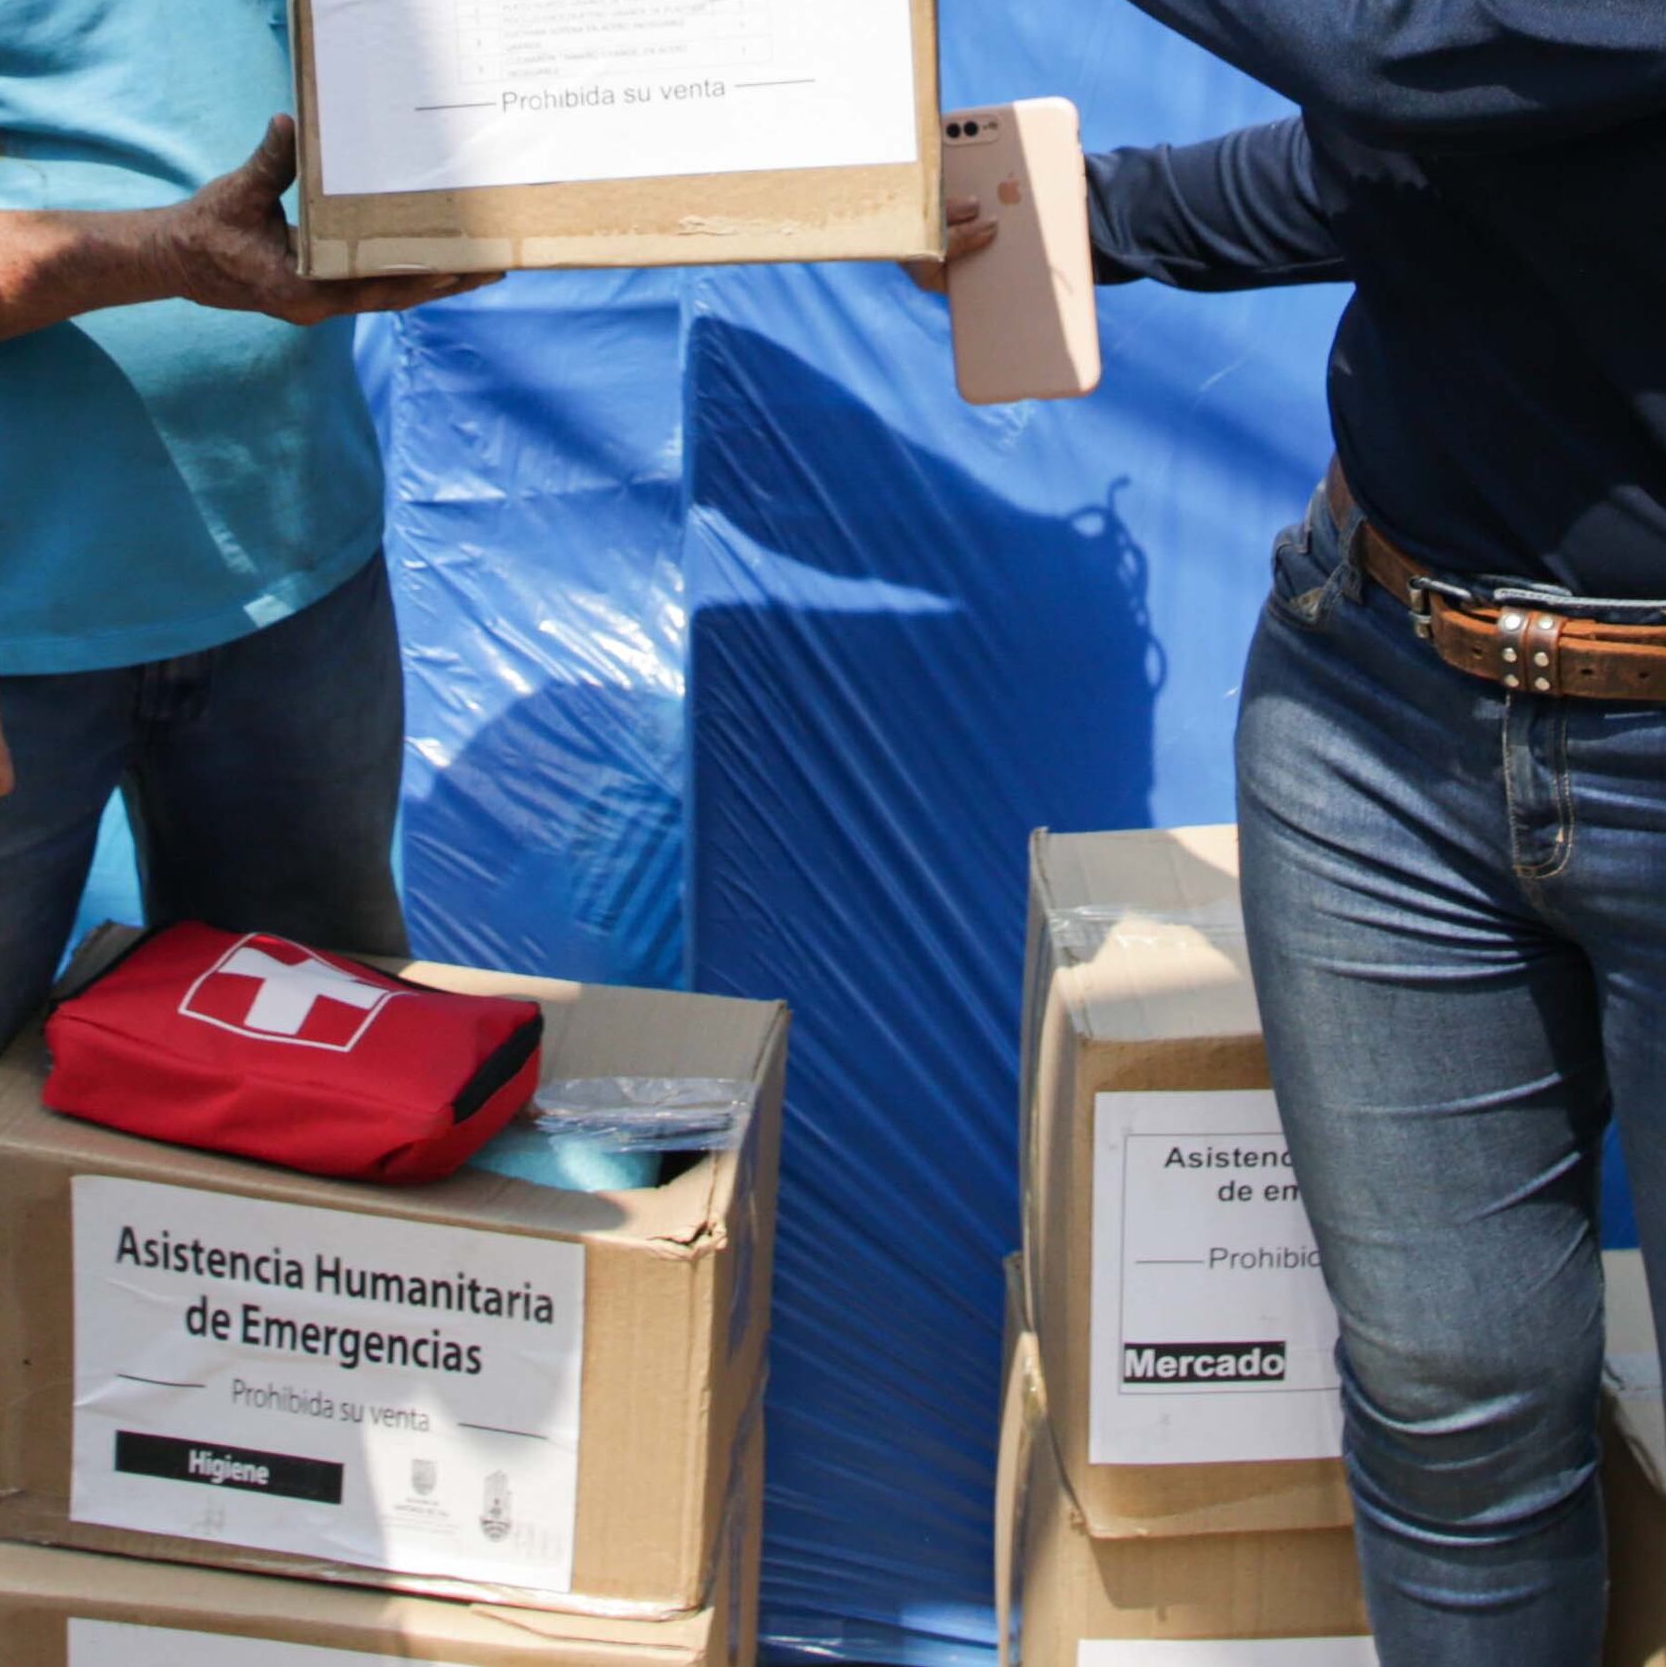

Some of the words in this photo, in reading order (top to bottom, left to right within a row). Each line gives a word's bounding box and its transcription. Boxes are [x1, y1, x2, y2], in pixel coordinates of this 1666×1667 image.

[502, 85, 615, 113] Prohibida
[623, 85, 651, 104] su
[660, 78, 726, 101] venta
[1218, 1180, 1253, 1202] de
[116, 1225, 304, 1290] Asistencia
[315, 1253, 555, 1325] Humanitaria
[186, 1295, 231, 1342] de
[240, 1304, 483, 1377] Emergencias
[1124, 1347, 1286, 1380] Mercado
[232, 1378, 334, 1420] Prohibida
[340, 1398, 364, 1422] su
[370, 1405, 432, 1433] venta
[187, 1448, 270, 1487] Higiene
